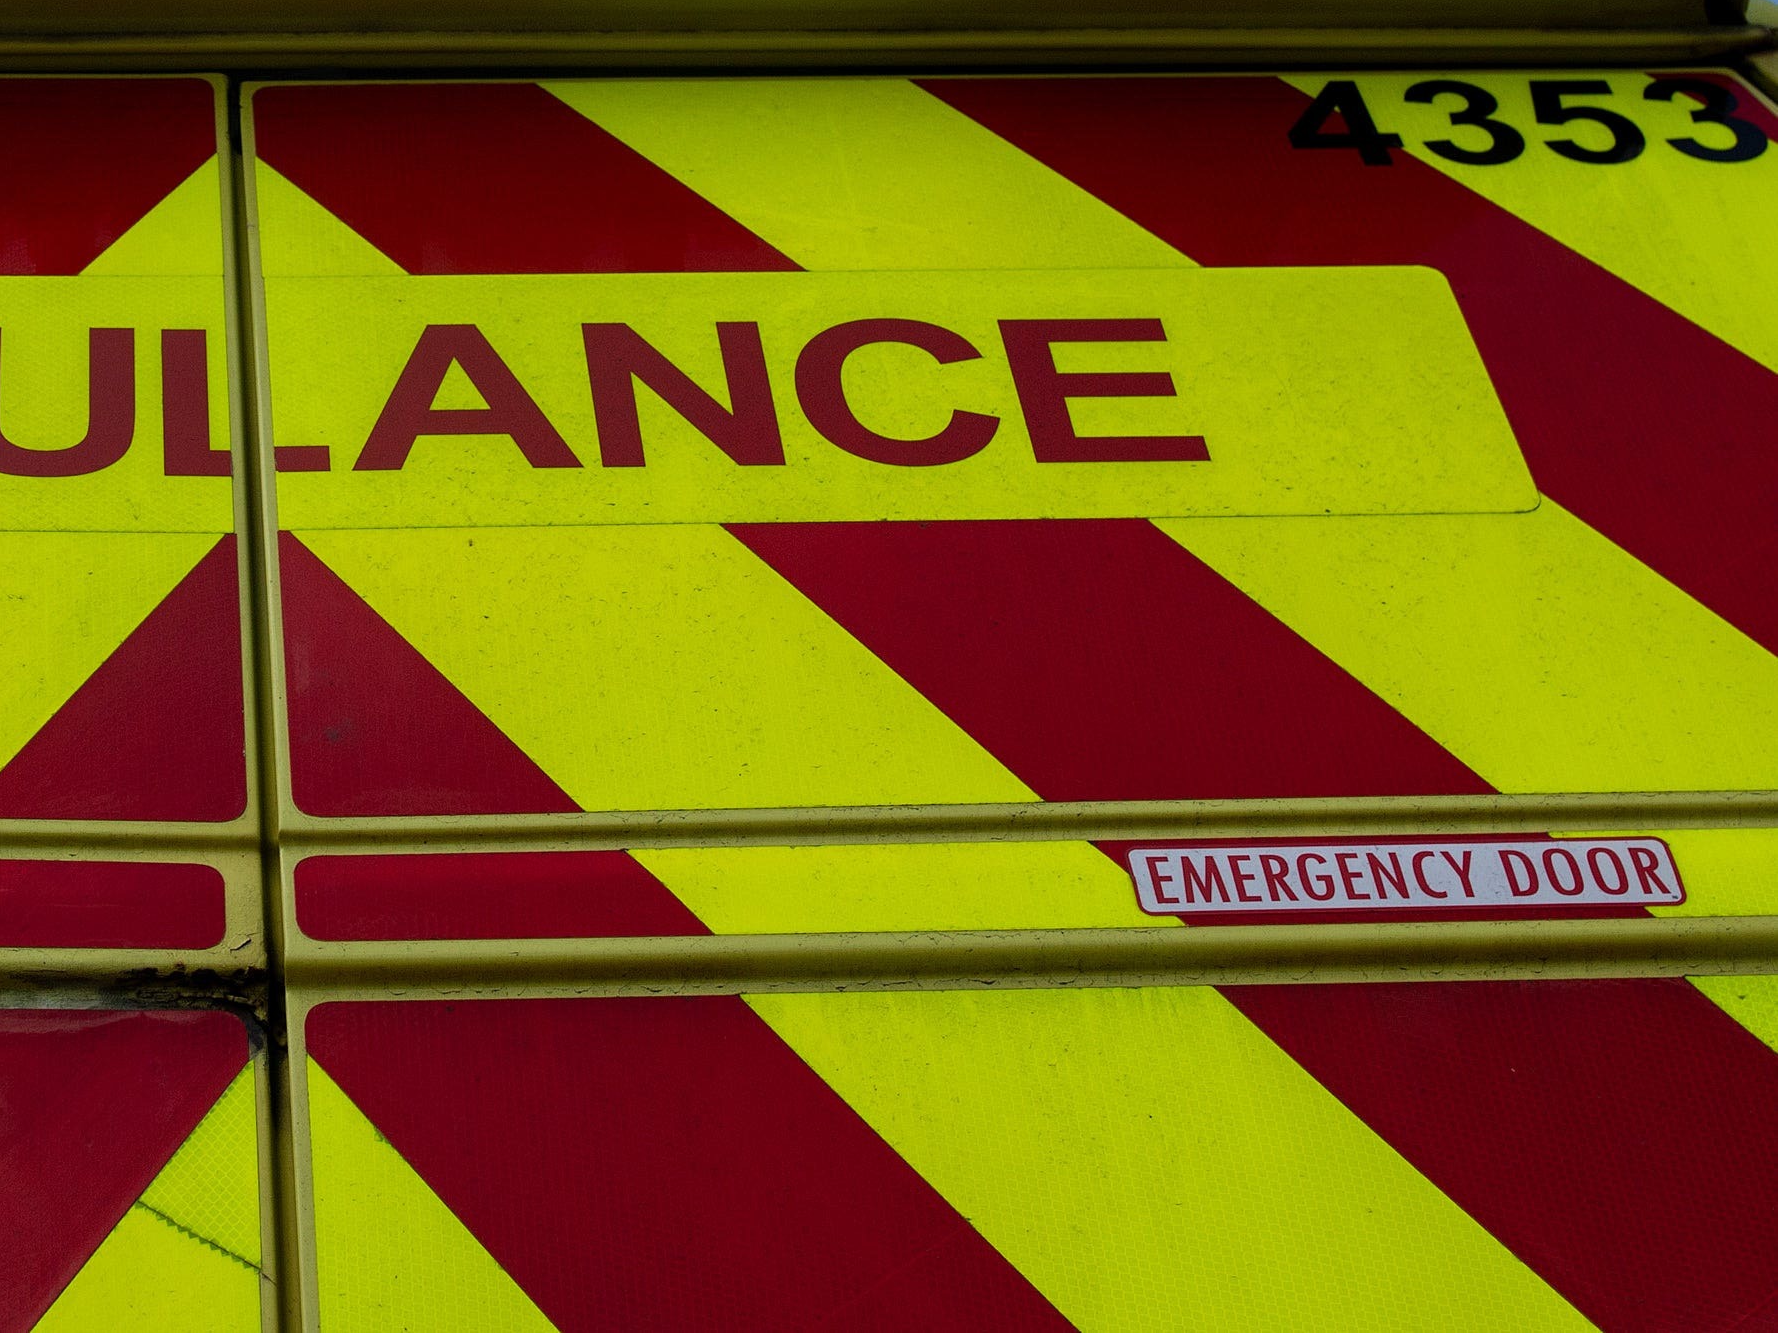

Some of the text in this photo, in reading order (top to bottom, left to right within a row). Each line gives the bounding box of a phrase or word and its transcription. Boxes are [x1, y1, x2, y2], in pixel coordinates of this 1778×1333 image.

[1287, 78, 1769, 167] 4353
[1145, 846, 1672, 905] EMERGENCY DOOR
